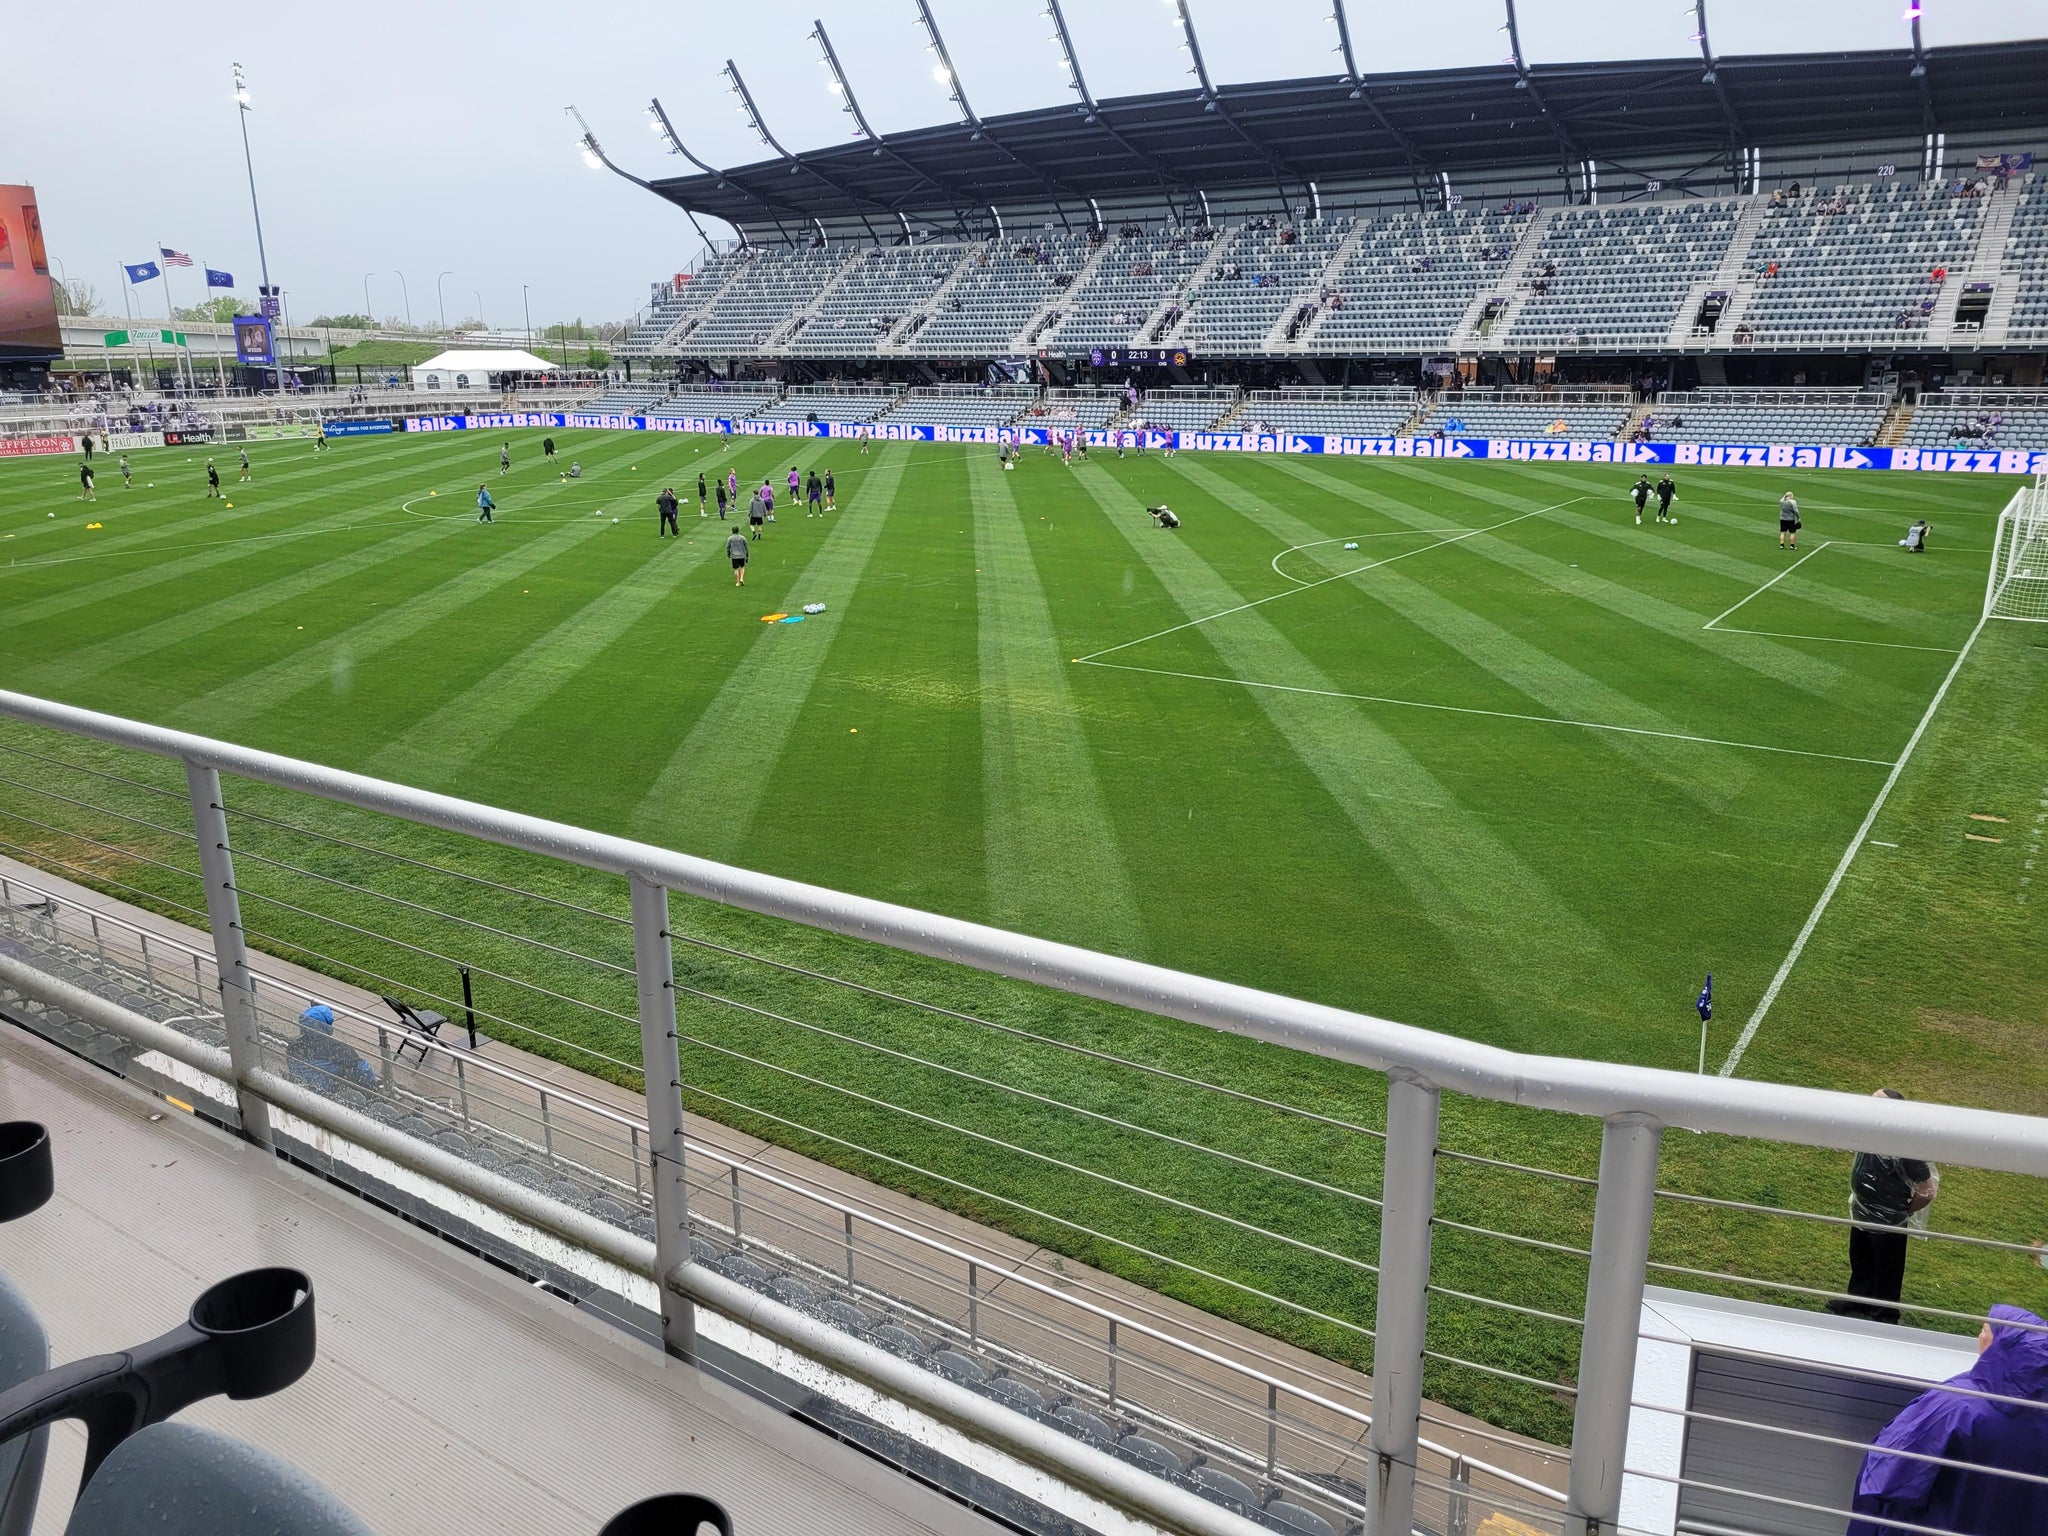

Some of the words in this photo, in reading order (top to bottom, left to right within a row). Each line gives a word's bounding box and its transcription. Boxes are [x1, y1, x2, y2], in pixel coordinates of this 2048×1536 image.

[1878, 165, 1894, 176] 220
[1648, 182, 1660, 191] 221
[1449, 195, 1462, 204] 222
[1295, 206, 1306, 214] 223
[1048, 350, 1067, 358] Health
[1111, 350, 1117, 360] 0
[1128, 350, 1148, 360] 22:13
[1160, 350, 1166, 360] 0
[111, 435, 131, 448] FFALO
[139, 434, 159, 447] TRACE
[183, 432, 212, 443] Health
[0, 438, 58, 449] EFFERSON
